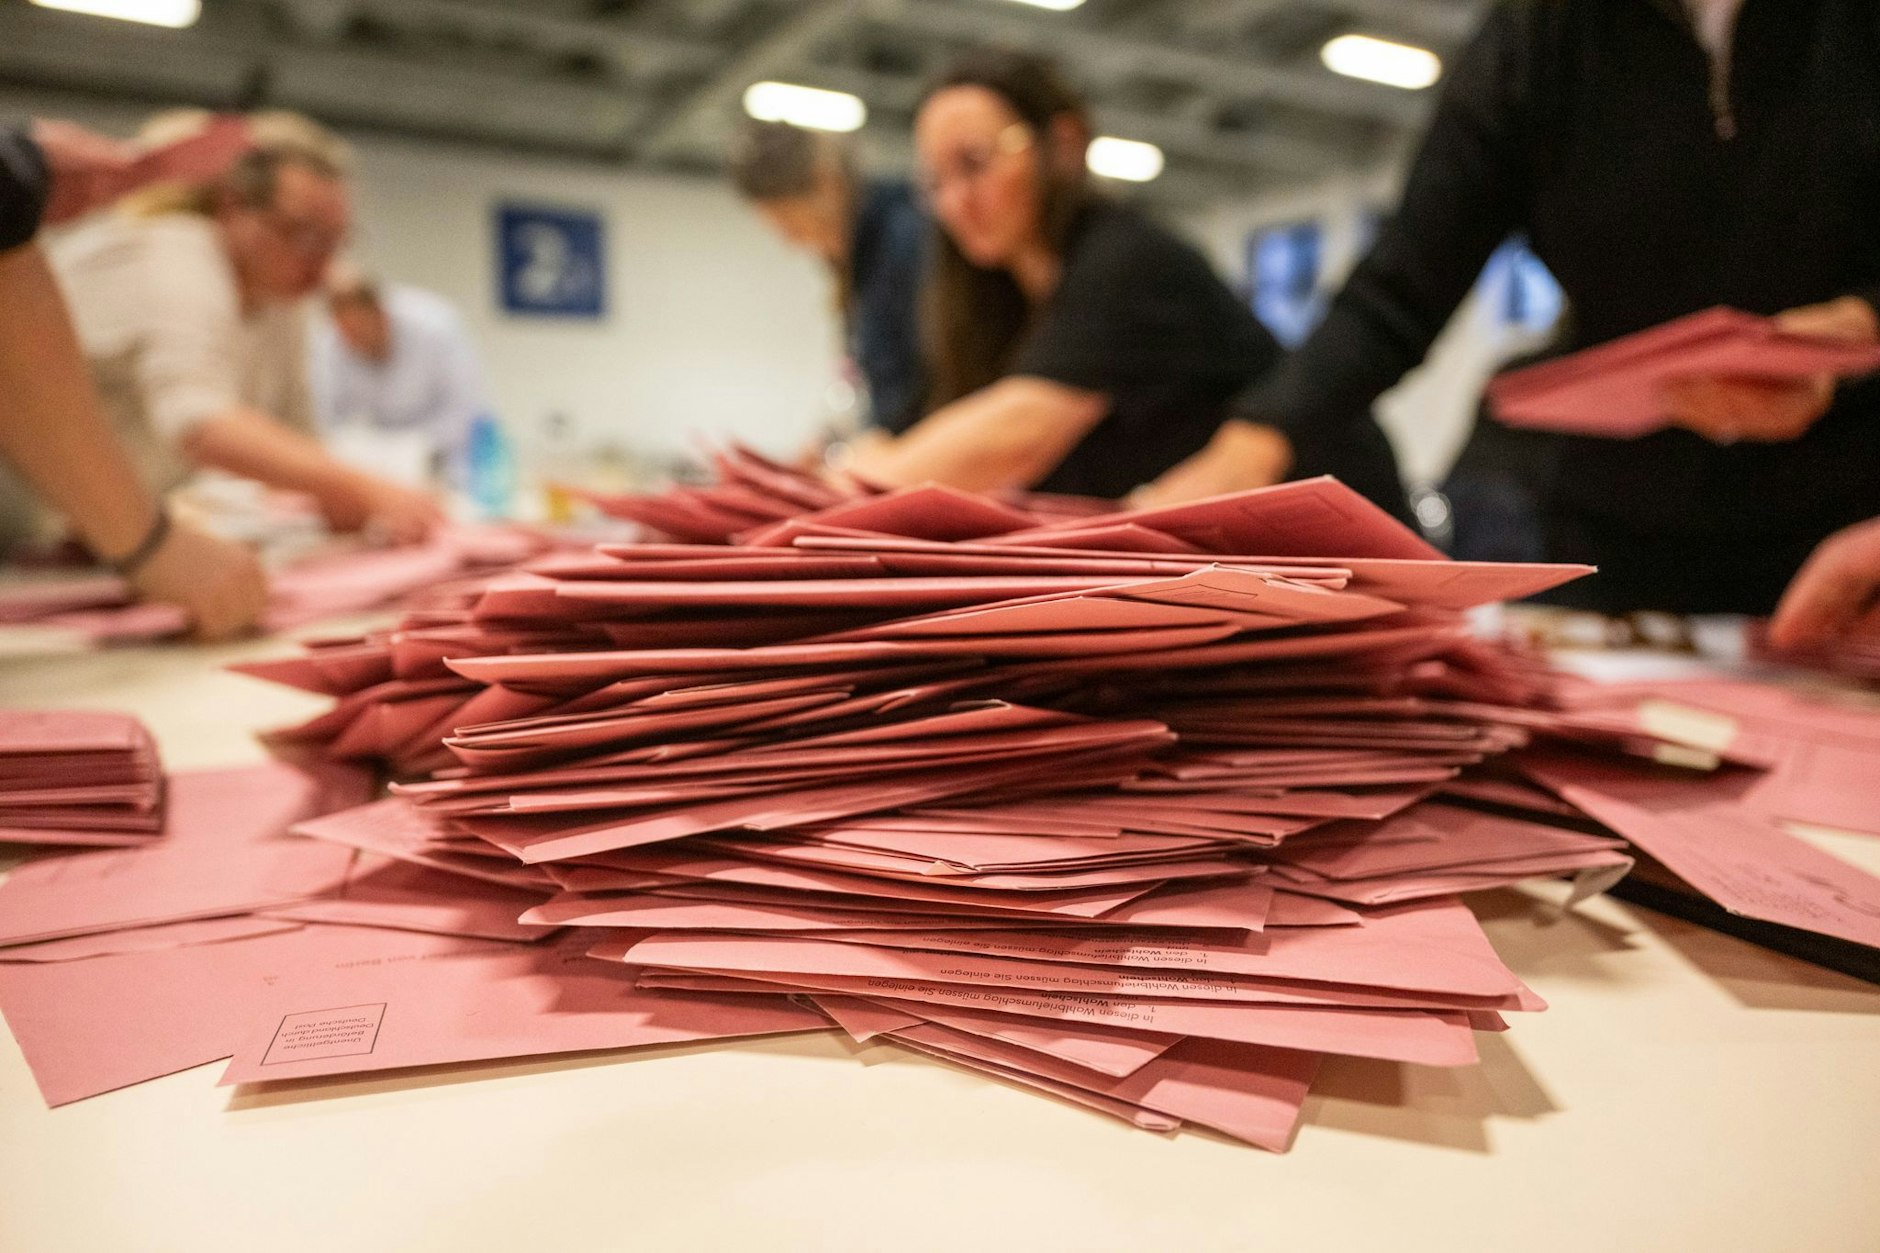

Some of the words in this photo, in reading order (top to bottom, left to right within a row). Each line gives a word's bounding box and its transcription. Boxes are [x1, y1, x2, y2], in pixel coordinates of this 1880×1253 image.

[922, 937, 970, 946] einlegen
[973, 942, 991, 950] Sie
[993, 944, 1038, 954] müssen
[1094, 948, 1161, 956] Wahlschein
[1039, 947, 1150, 963] Wahlbriefumschlag
[1153, 956, 1193, 964] diesen
[940, 969, 990, 978] einlegen
[994, 973, 1012, 981] Sie
[1118, 974, 1188, 983] Wahlschein
[1016, 974, 1059, 984] müssen
[868, 979, 915, 992] einlegen
[1063, 978, 1179, 991] Wahlbriefumschlag
[1182, 984, 1222, 992] diesen
[918, 986, 936, 996] Sie
[938, 988, 980, 1000] müssen
[982, 994, 1095, 1016] Wahlbriefumschlag
[1040, 993, 1109, 1008] Wahlschein
[1112, 1001, 1136, 1010] den
[1099, 1008, 1140, 1022] diesen
[1142, 1014, 1154, 1024] In
